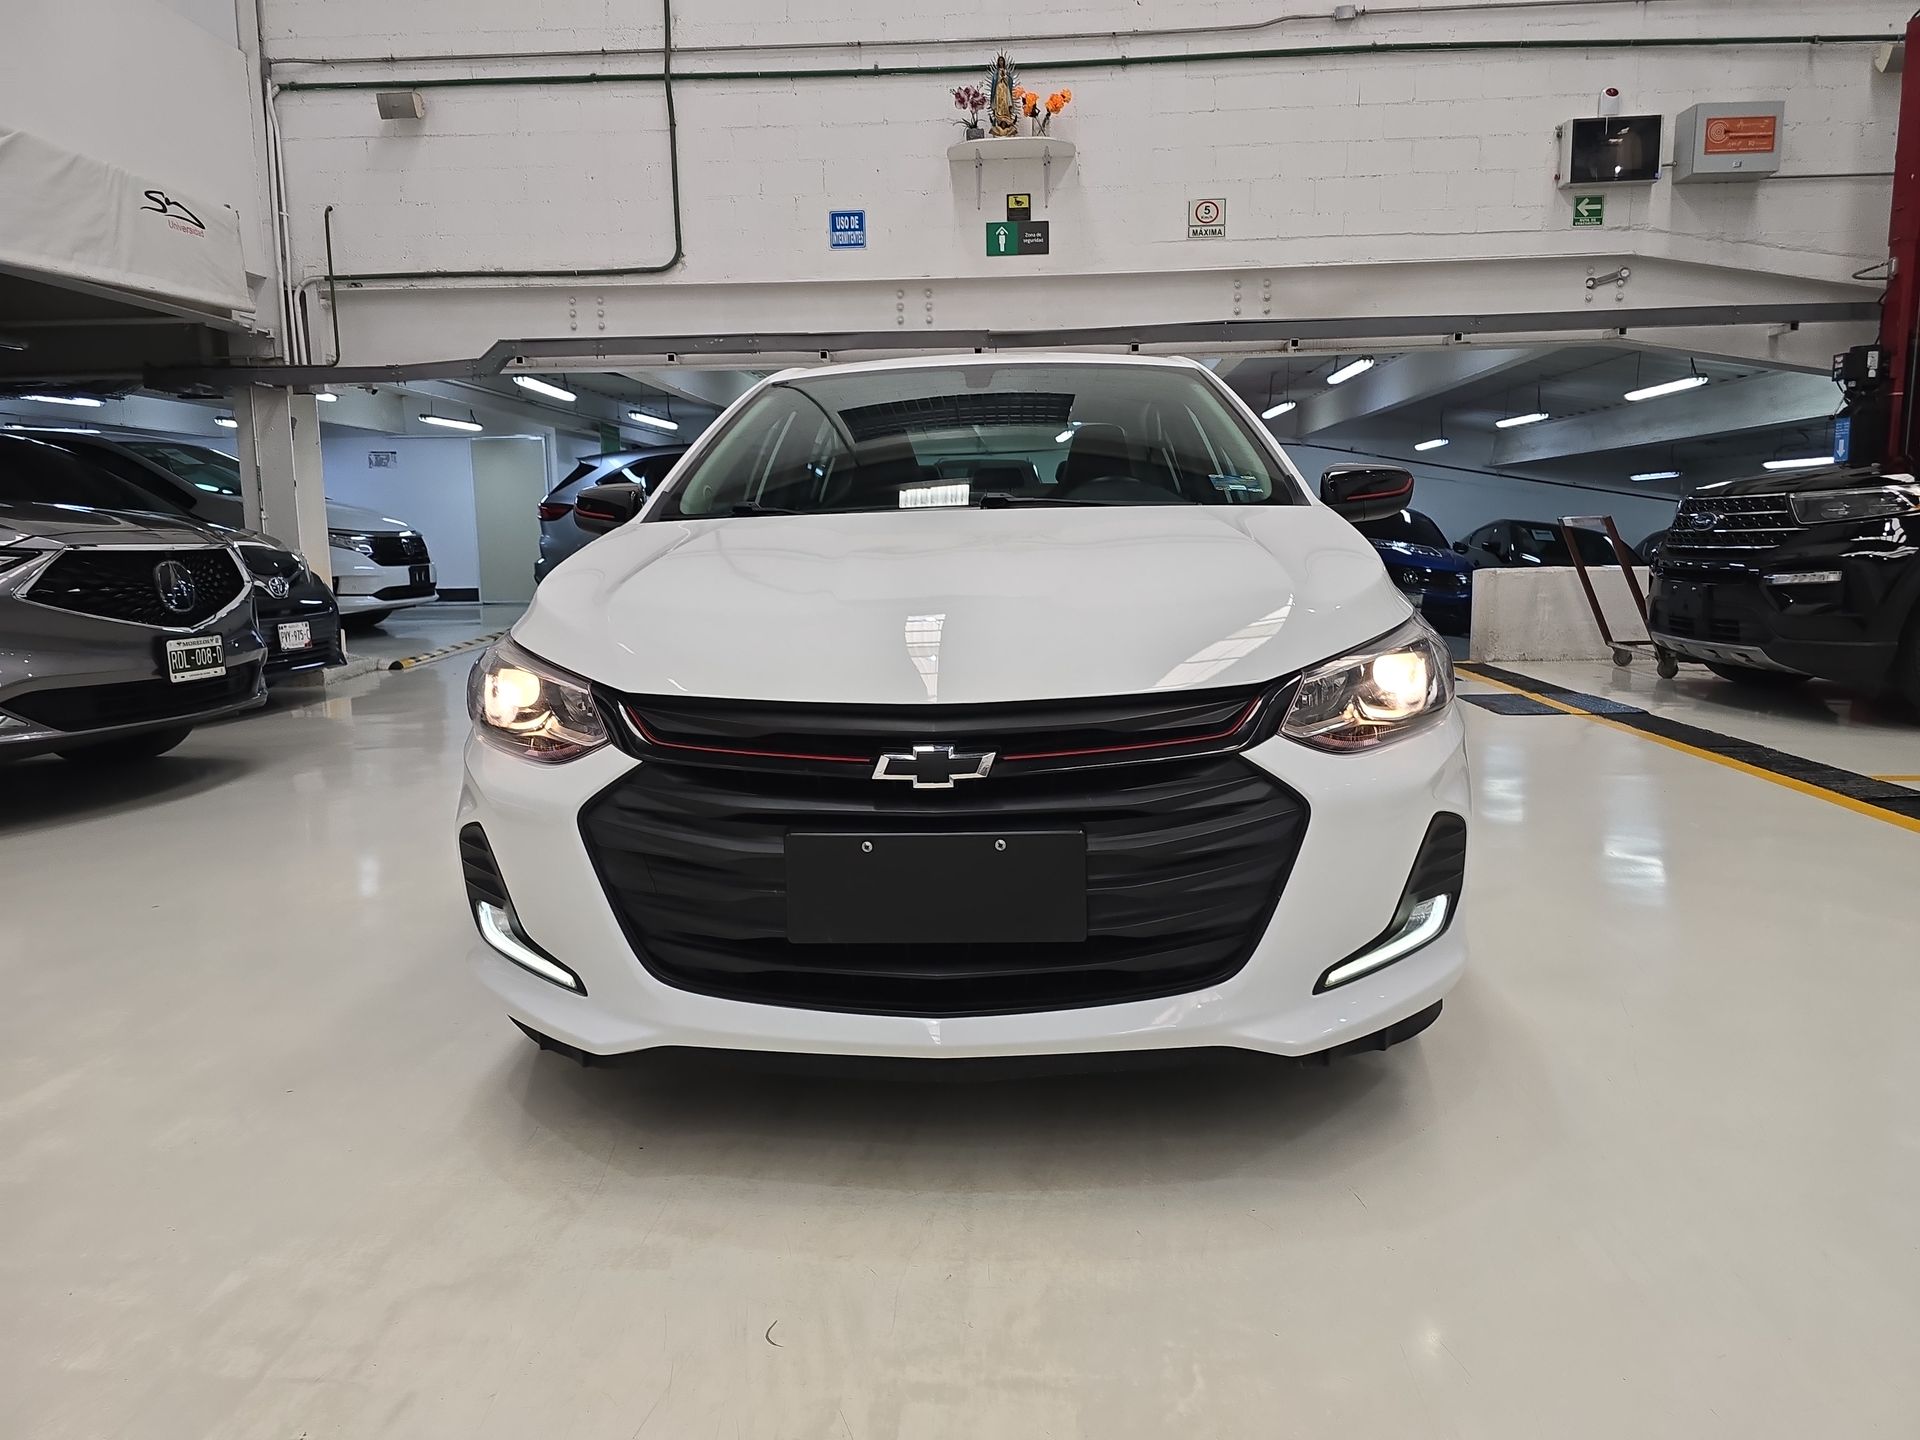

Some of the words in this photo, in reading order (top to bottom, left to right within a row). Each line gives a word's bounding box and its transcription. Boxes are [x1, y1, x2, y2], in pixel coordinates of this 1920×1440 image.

[1204, 205, 1211, 215] 5
[168, 219, 205, 238] Universidad
[835, 216, 850, 230] USO
[850, 216, 859, 229] DE
